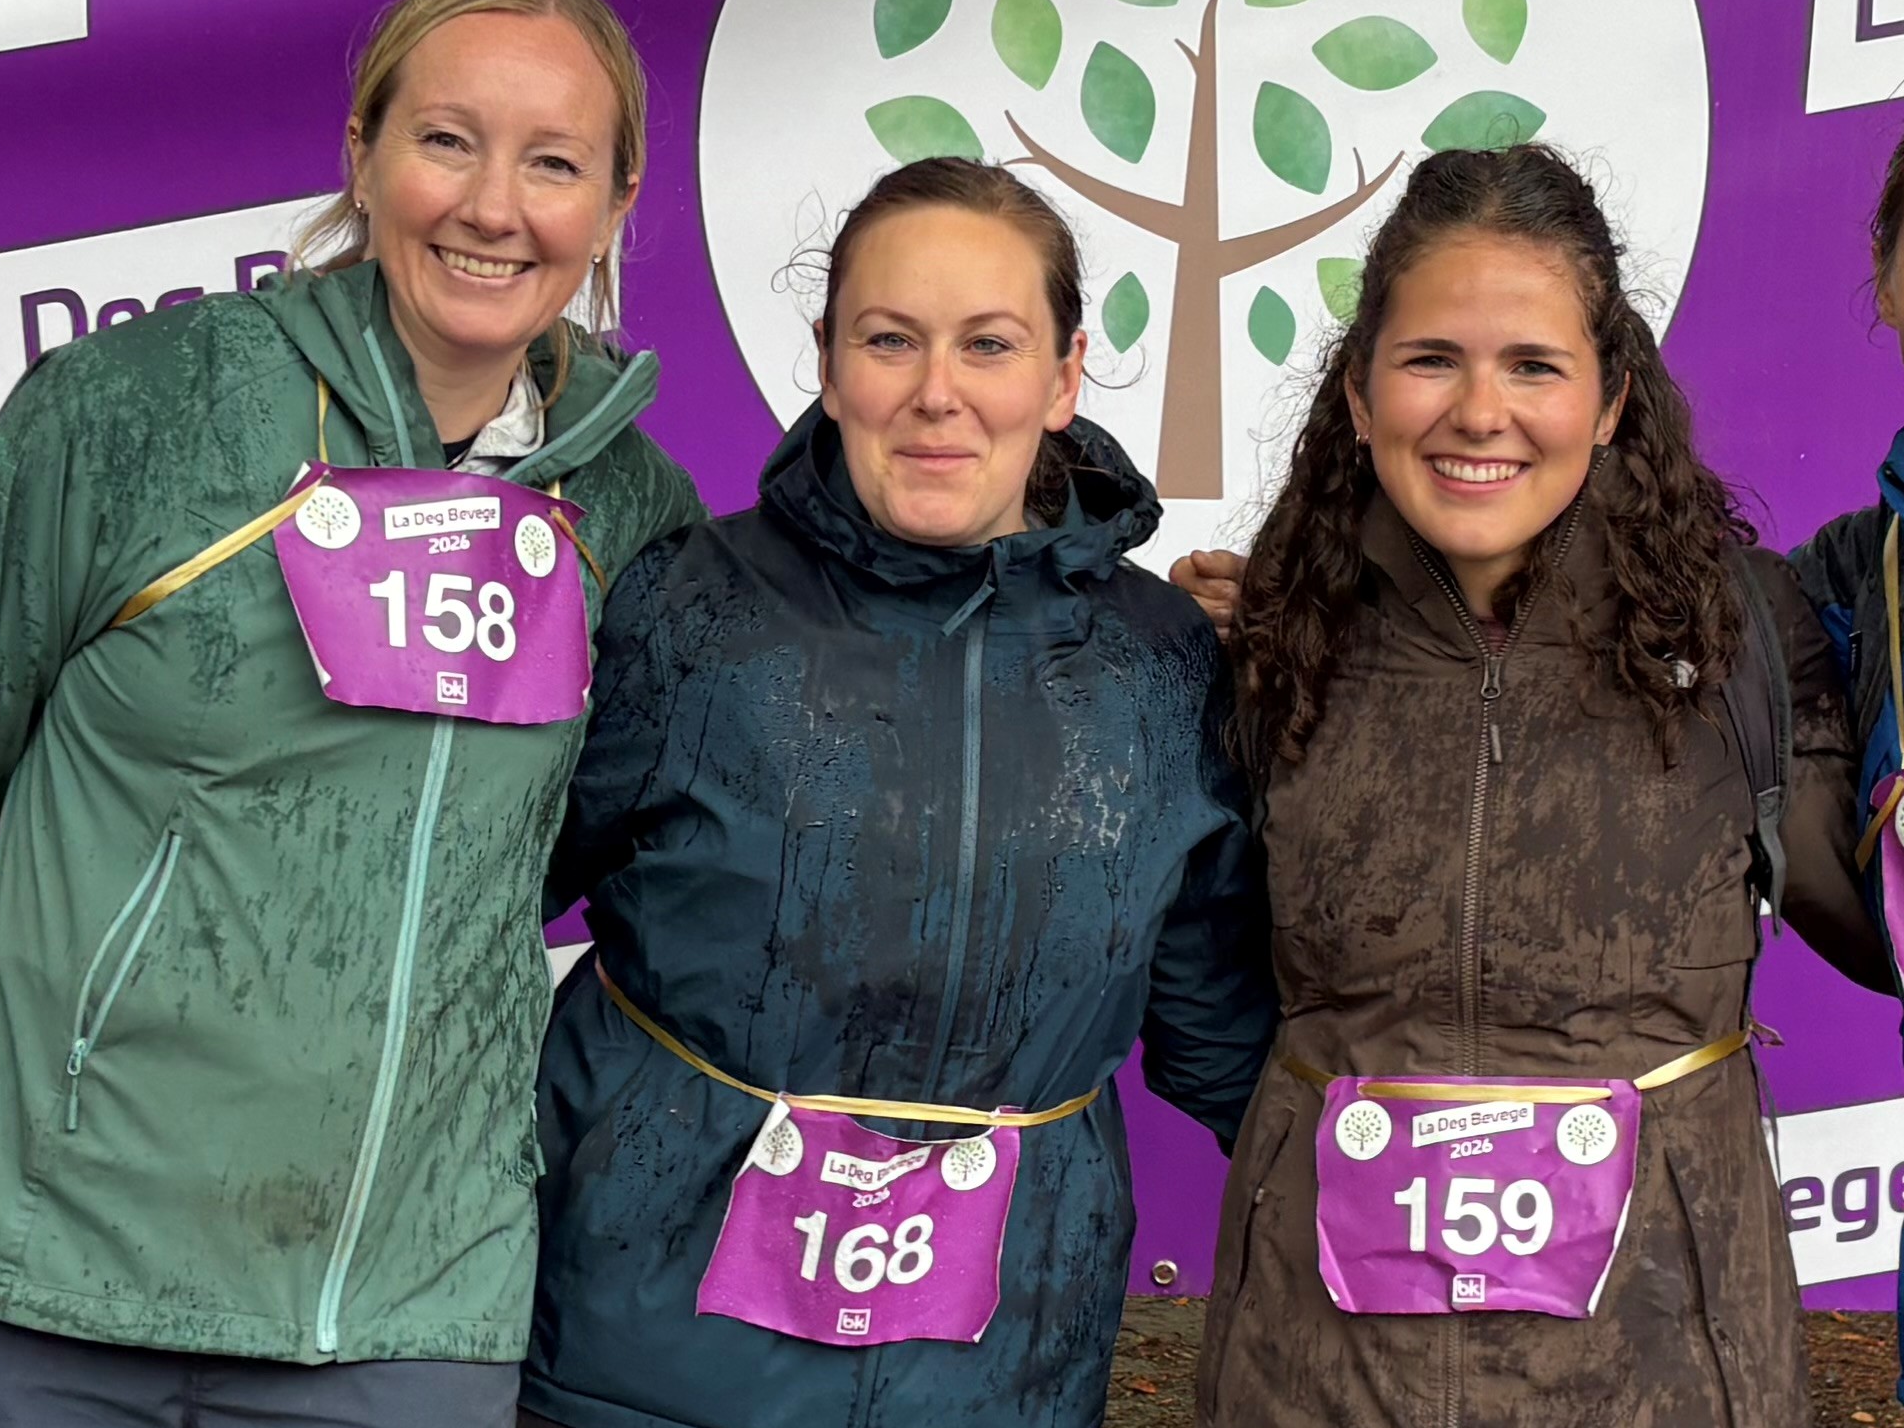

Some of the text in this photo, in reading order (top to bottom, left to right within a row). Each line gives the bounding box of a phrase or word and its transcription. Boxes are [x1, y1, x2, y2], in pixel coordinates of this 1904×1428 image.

[392, 514, 410, 528] La
[414, 512, 444, 526] Deg
[428, 534, 470, 554] 2026
[369, 570, 516, 661] 158
[1418, 1122, 1435, 1136] La
[1450, 1138, 1493, 1159] 2026
[1394, 1177, 1553, 1255] 159
[794, 1210, 934, 1293] 168
